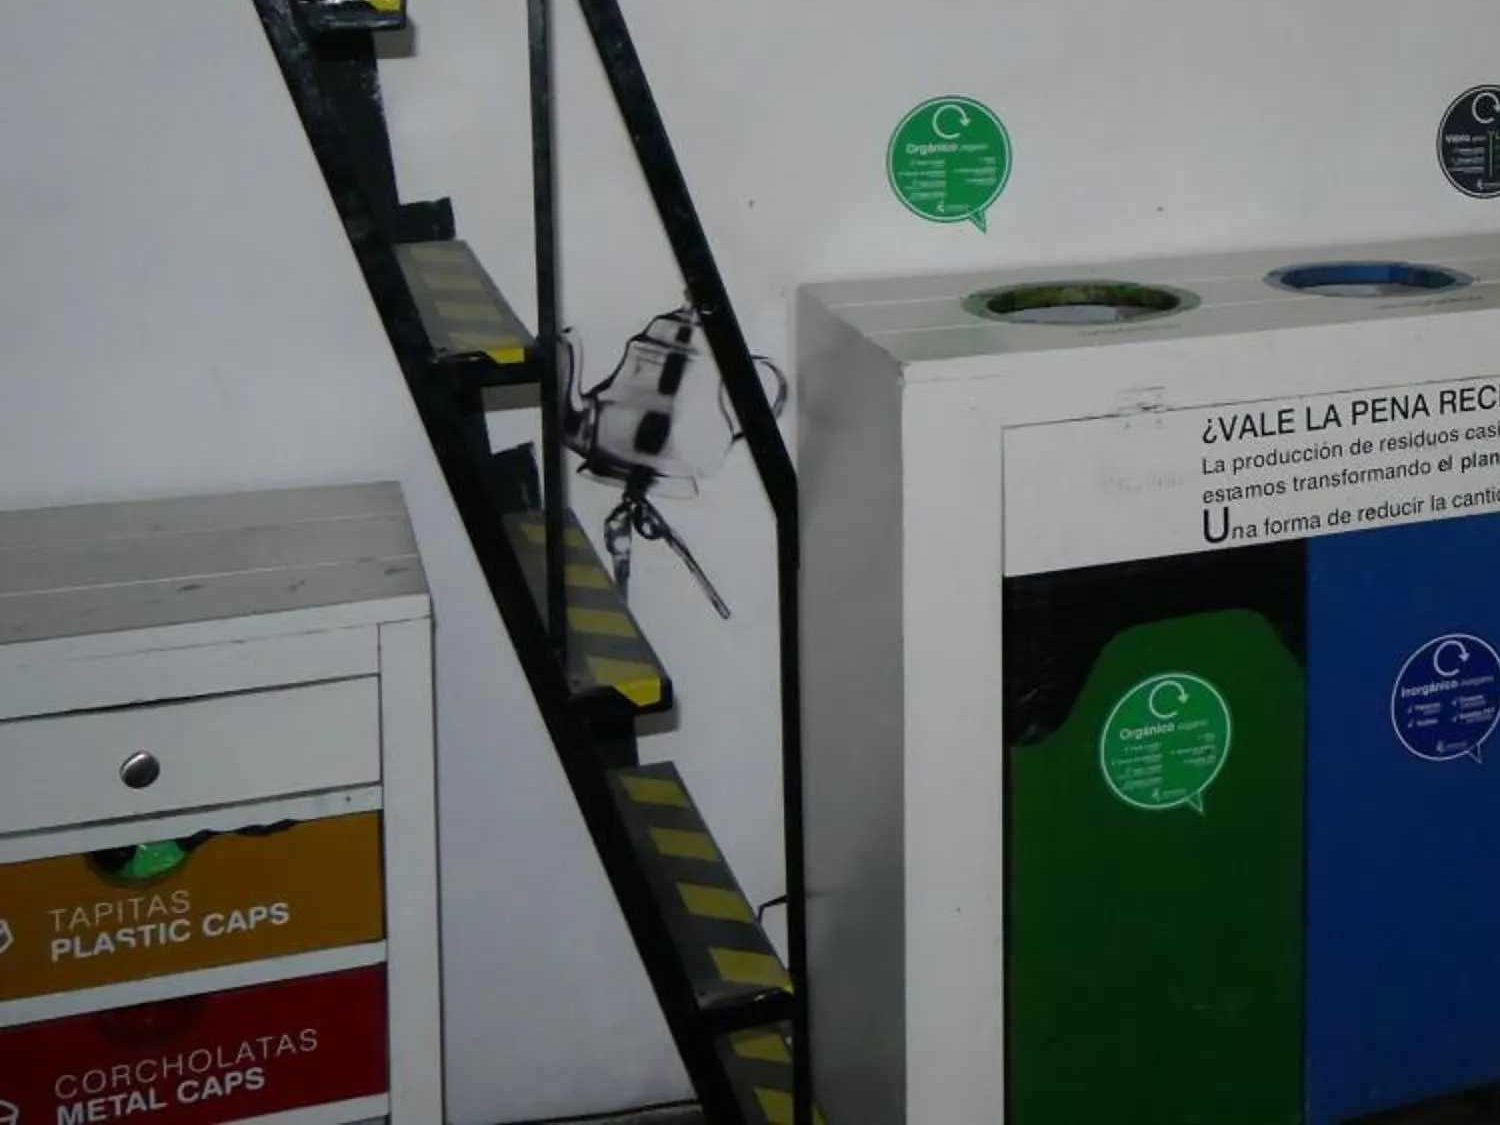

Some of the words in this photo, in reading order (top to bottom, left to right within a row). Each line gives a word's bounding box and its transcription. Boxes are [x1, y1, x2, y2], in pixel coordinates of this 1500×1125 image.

[1202, 407, 1296, 444] ¿VALE
[1306, 403, 1342, 431] LA
[1351, 393, 1430, 425] PENA
[1202, 458, 1225, 475] La
[1232, 442, 1343, 475] producción
[1349, 437, 1374, 457] de
[1379, 425, 1459, 453] residuos
[1465, 421, 1500, 441] casi
[1293, 458, 1431, 491] transformando
[1437, 454, 1453, 473] el
[1203, 506, 1257, 543] Una
[1264, 514, 1321, 536] forma
[1327, 508, 1351, 526] de
[1357, 497, 1424, 523] reducir
[1431, 494, 1448, 512] la
[48, 889, 192, 933] TAPITAS
[50, 918, 192, 963] PLASTIC
[201, 902, 290, 938] CAPS
[54, 1028, 320, 1100] CORCHOLATAS
[56, 1086, 168, 1125] METAL
[176, 1066, 266, 1104] CAPS
